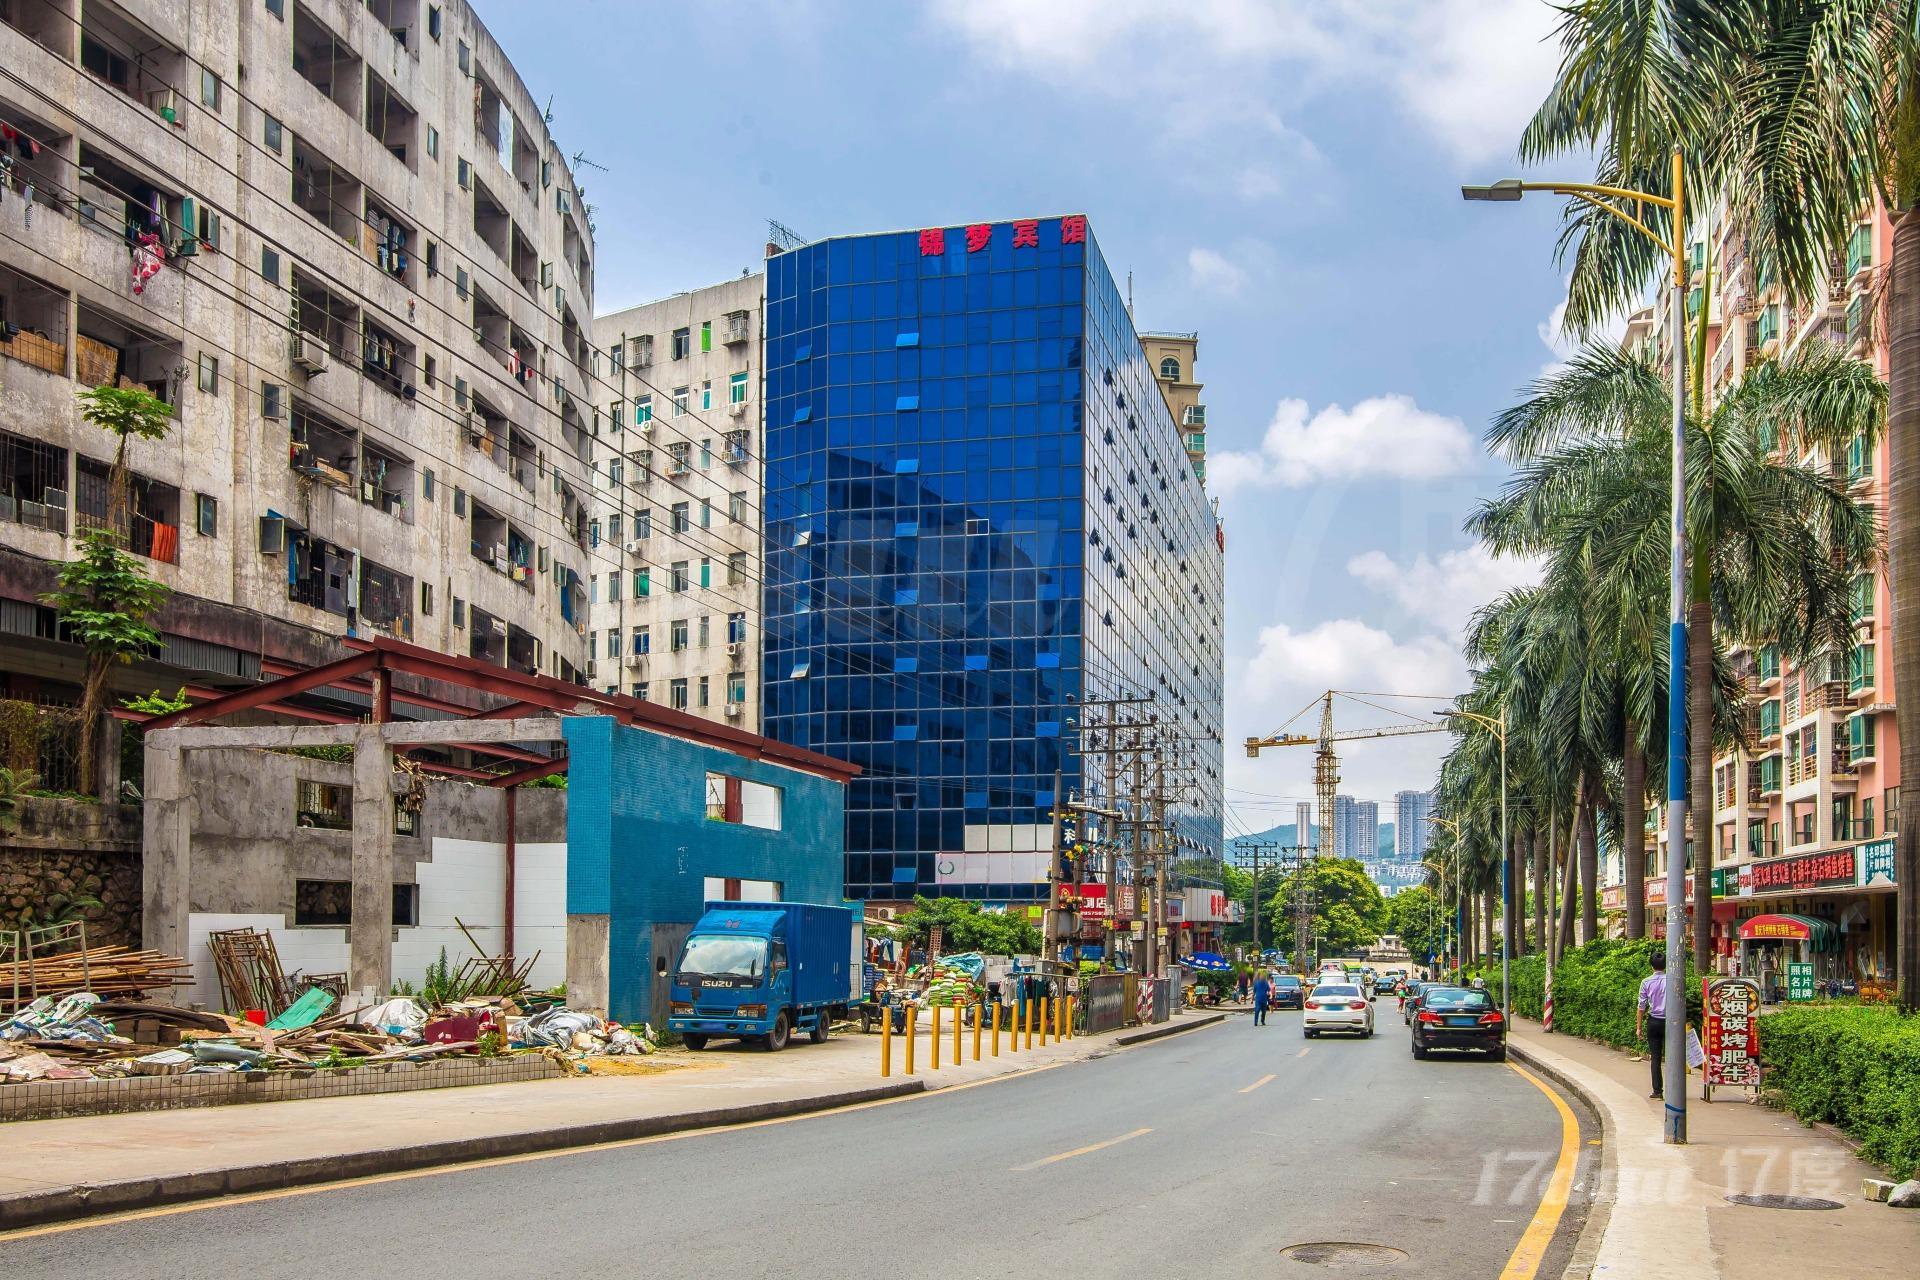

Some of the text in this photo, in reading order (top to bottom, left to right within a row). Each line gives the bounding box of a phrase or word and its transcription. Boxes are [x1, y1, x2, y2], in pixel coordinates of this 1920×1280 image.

[918, 215, 1087, 256] 锦梦宾馆
[1790, 965, 1812, 975] 照相
[701, 980, 733, 988] ISUZU
[1791, 977, 1812, 987] 名片
[1790, 989, 1813, 999] 招牌
[1720, 984, 1749, 1081] 无烟碳烤肥牛
